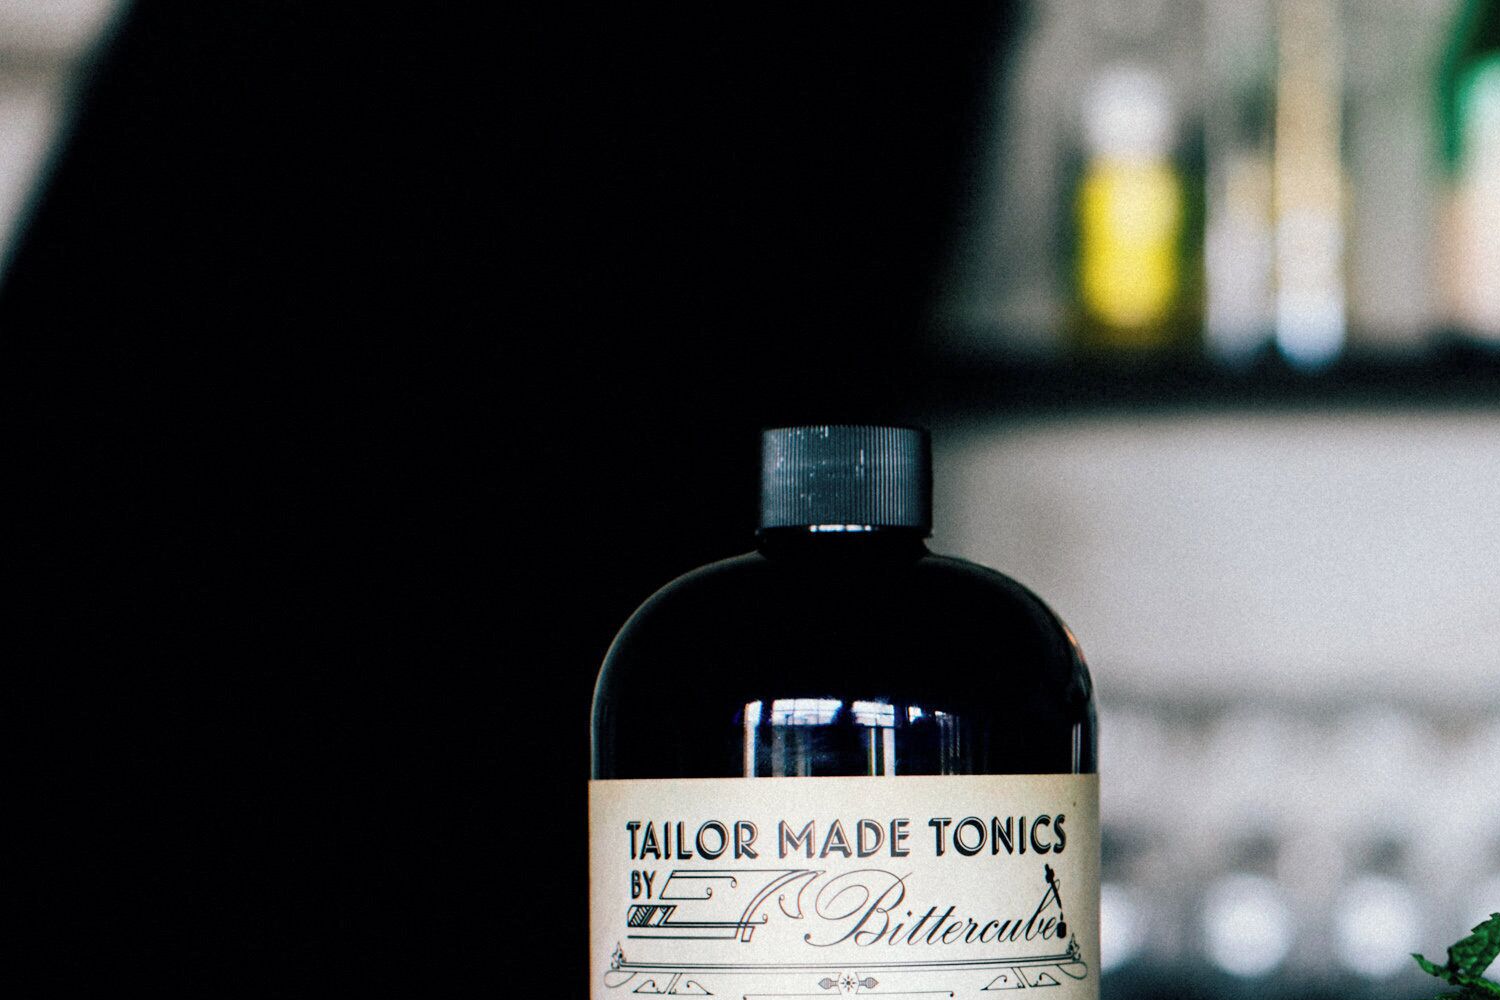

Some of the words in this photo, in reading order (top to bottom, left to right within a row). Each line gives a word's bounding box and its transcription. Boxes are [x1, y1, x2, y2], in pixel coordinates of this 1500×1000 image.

[626, 819, 759, 860] TAILOR
[778, 818, 911, 860] MADE
[928, 813, 1067, 857] TONICS
[630, 869, 657, 900] BY
[804, 868, 1060, 947] Bittercube
